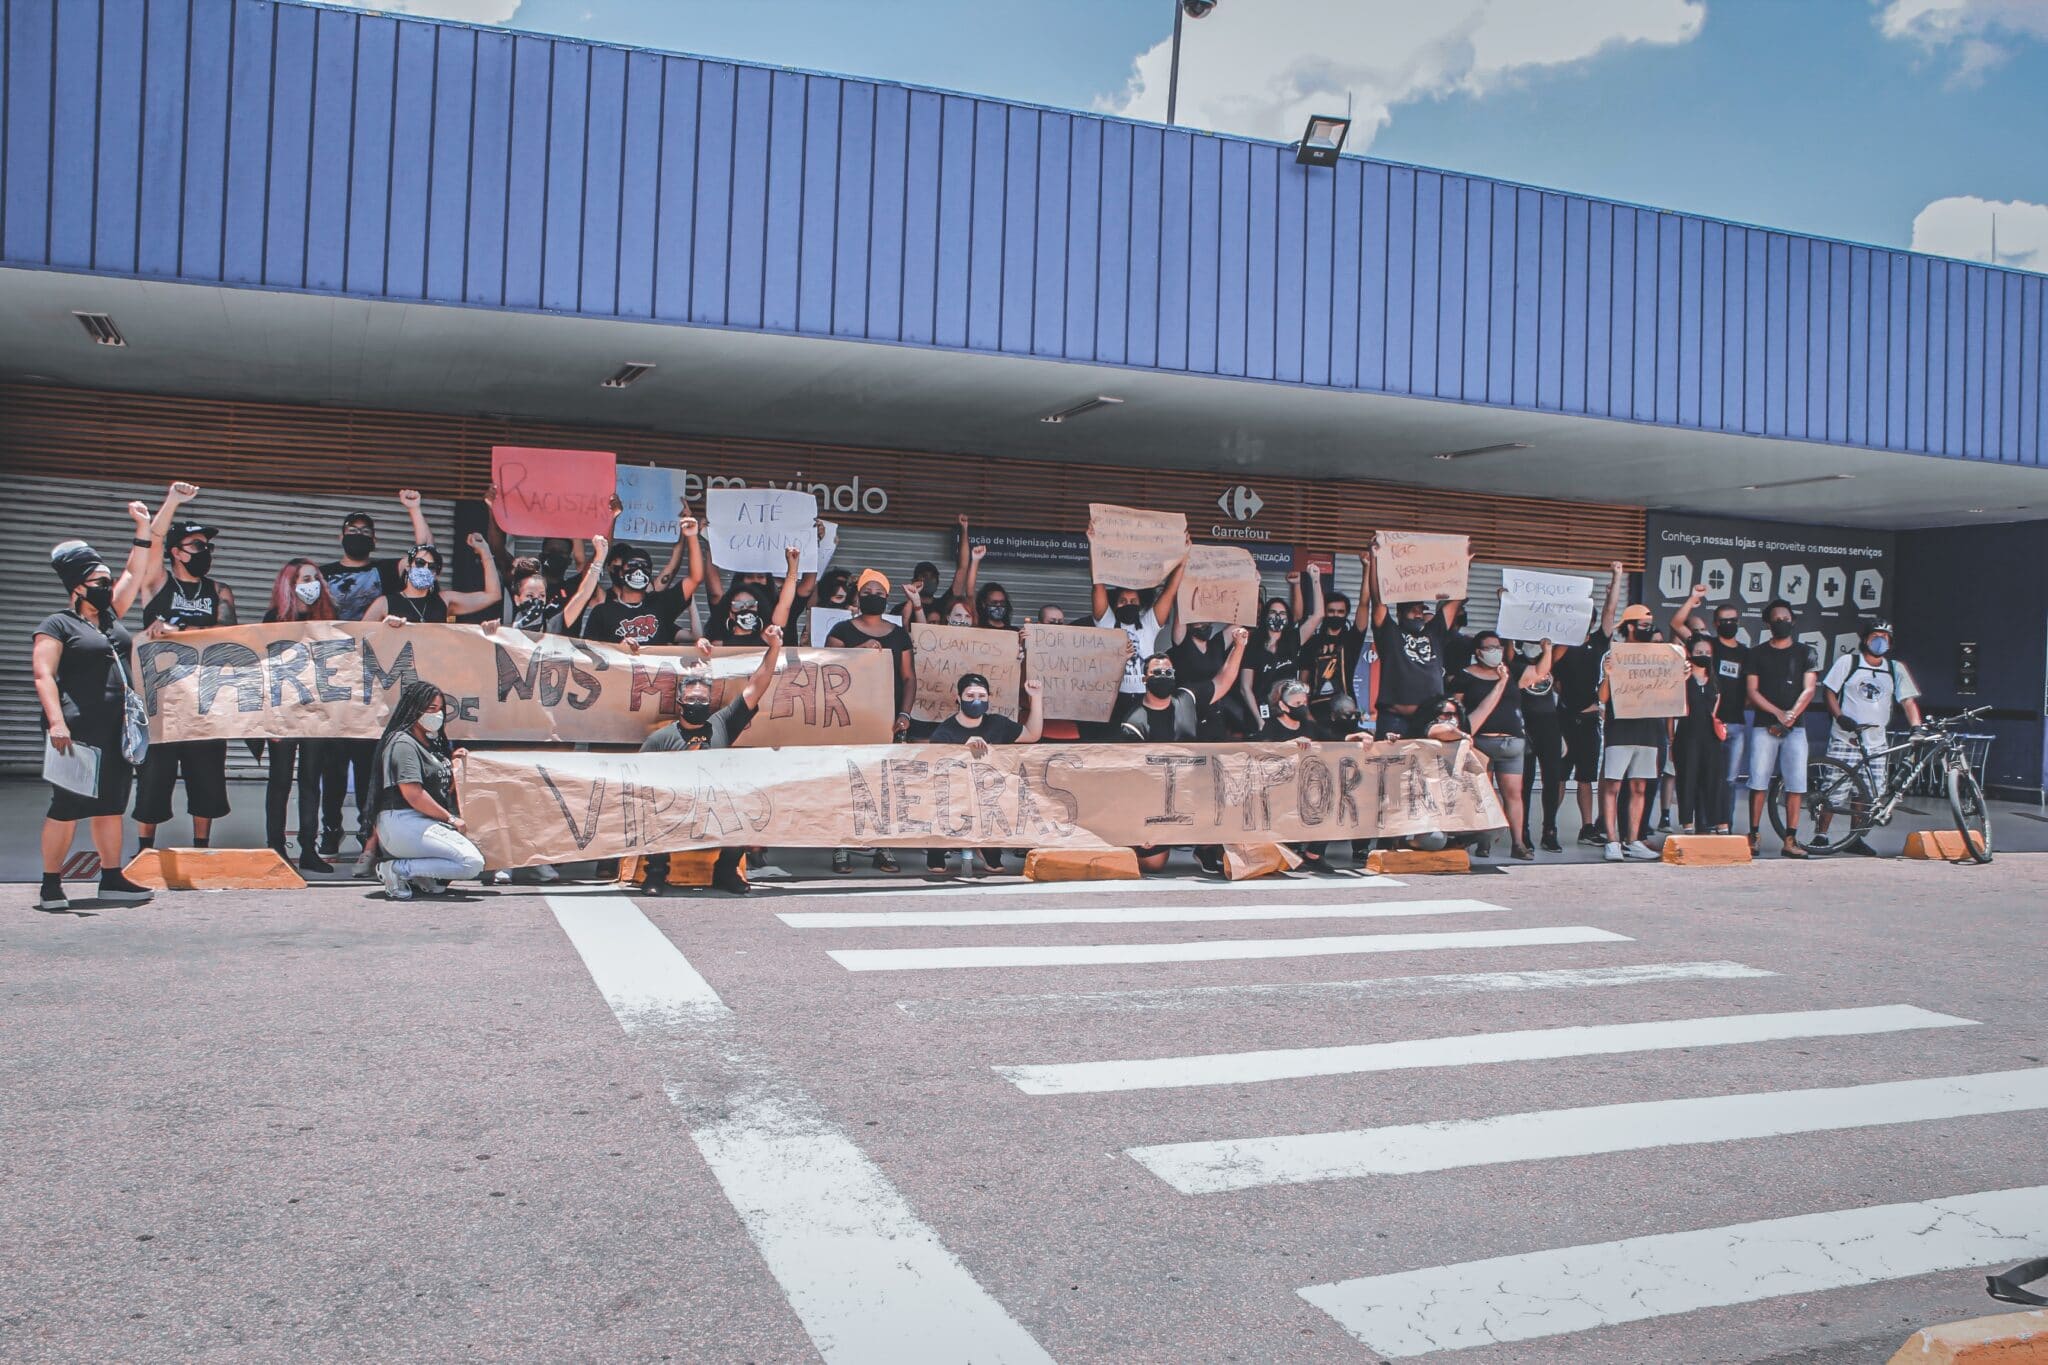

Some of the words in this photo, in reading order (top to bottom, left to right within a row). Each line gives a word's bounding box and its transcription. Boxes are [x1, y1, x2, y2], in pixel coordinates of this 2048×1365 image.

[738, 494, 785, 525] ATÉ
[1211, 525, 1271, 540] Carrefour
[729, 530, 812, 557] QUANDO?
[993, 537, 1005, 545] de
[1006, 537, 1060, 548] higienização
[1062, 540, 1077, 549] das
[1661, 530, 1701, 545] Conheça
[1703, 535, 1734, 546] nossas
[1735, 536, 1757, 549] lojas
[1765, 540, 1806, 552] aproveite
[1807, 545, 1817, 553] os
[1818, 545, 1847, 555] nossos
[1848, 547, 1883, 559] serviços
[1252, 553, 1291, 563] ENIZAÇÃO
[1513, 578, 1576, 597] PORQUE
[1528, 600, 1576, 614] TANTO
[919, 629, 1002, 656] QUANTOS
[1035, 628, 1065, 648] POR
[1073, 632, 1106, 648] UMA
[137, 636, 421, 717] PAREM
[496, 637, 610, 711] NOS
[630, 656, 852, 728] MAR
[977, 663, 1014, 681] TEM
[536, 759, 773, 850] VIDAS
[847, 753, 1084, 838] NEGRAS
